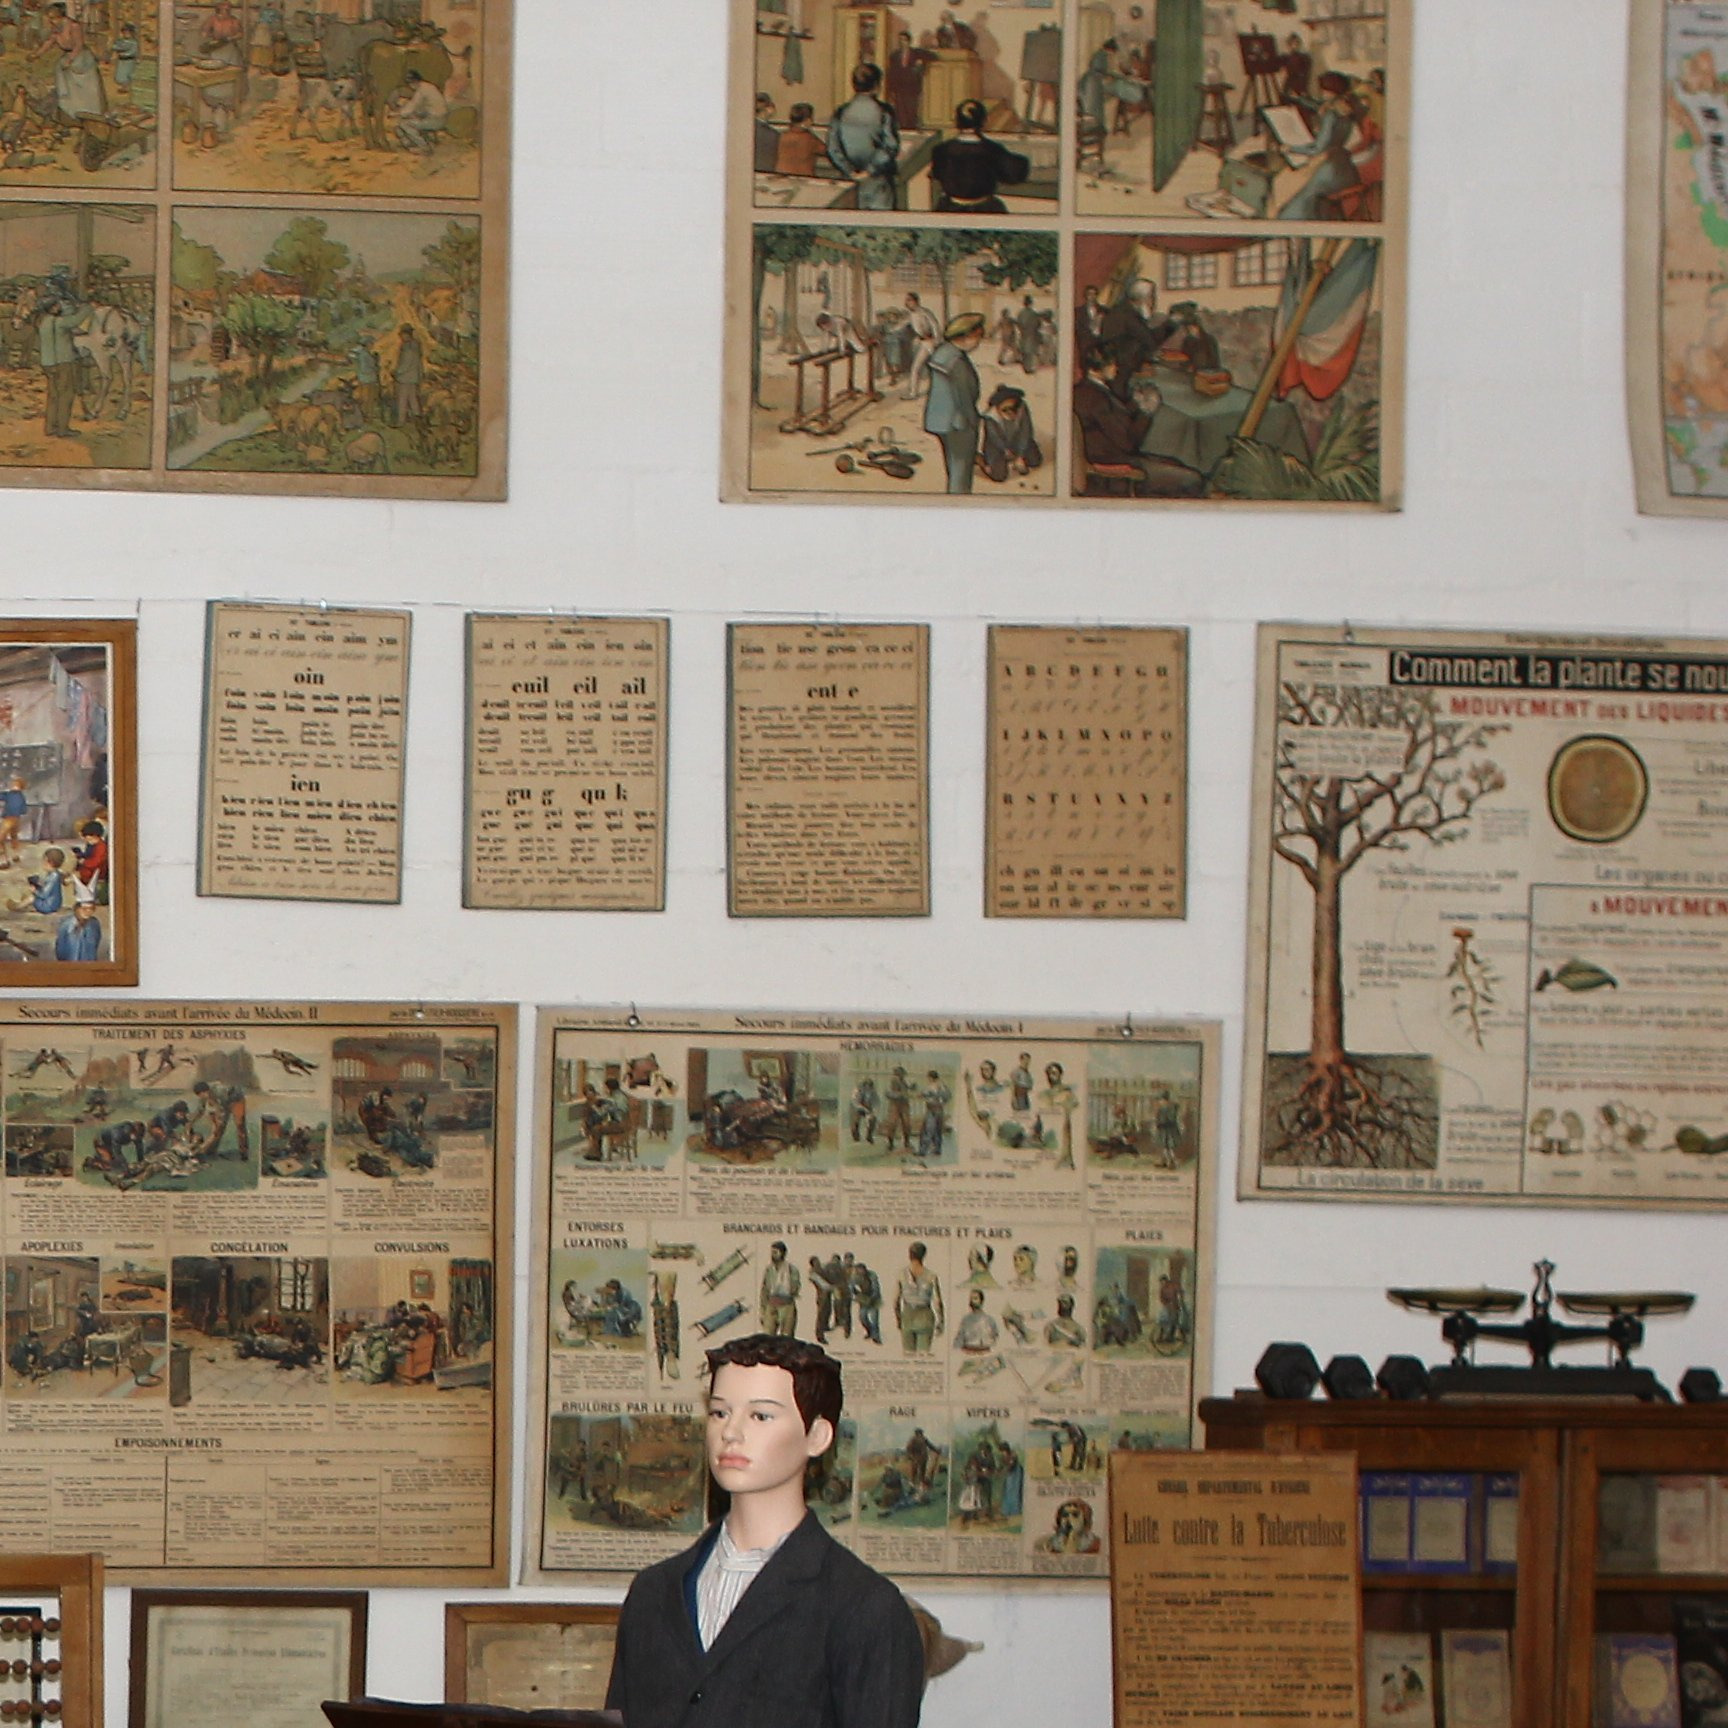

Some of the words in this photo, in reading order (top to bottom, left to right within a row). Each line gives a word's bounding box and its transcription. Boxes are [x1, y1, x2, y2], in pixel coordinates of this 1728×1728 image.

[294, 667, 324, 685] oin
[1392, 652, 1520, 684] Comment
[1527, 653, 1552, 684] la
[1559, 655, 1641, 691] plante
[1648, 665, 1678, 689] se
[573, 676, 597, 694] eil
[621, 676, 646, 694] ail
[1451, 697, 1588, 719] MOUVEMENT
[93, 1028, 157, 1040] TRAITEMENT
[163, 1029, 184, 1040] DES
[190, 1029, 246, 1041] ASPHYXIES
[568, 1221, 624, 1233] ENTORSES
[21, 1242, 84, 1252] APOPLEXIES
[374, 1242, 449, 1253] CONVULSIONS
[563, 1238, 628, 1249] LUXATIONS
[115, 1438, 222, 1449] EMPOISONNEMENTS
[1123, 1512, 1160, 1546] Lutte
[1173, 1516, 1220, 1547] contre
[1231, 1513, 1245, 1546] la
[1257, 1512, 1346, 1547] Tuberculose
